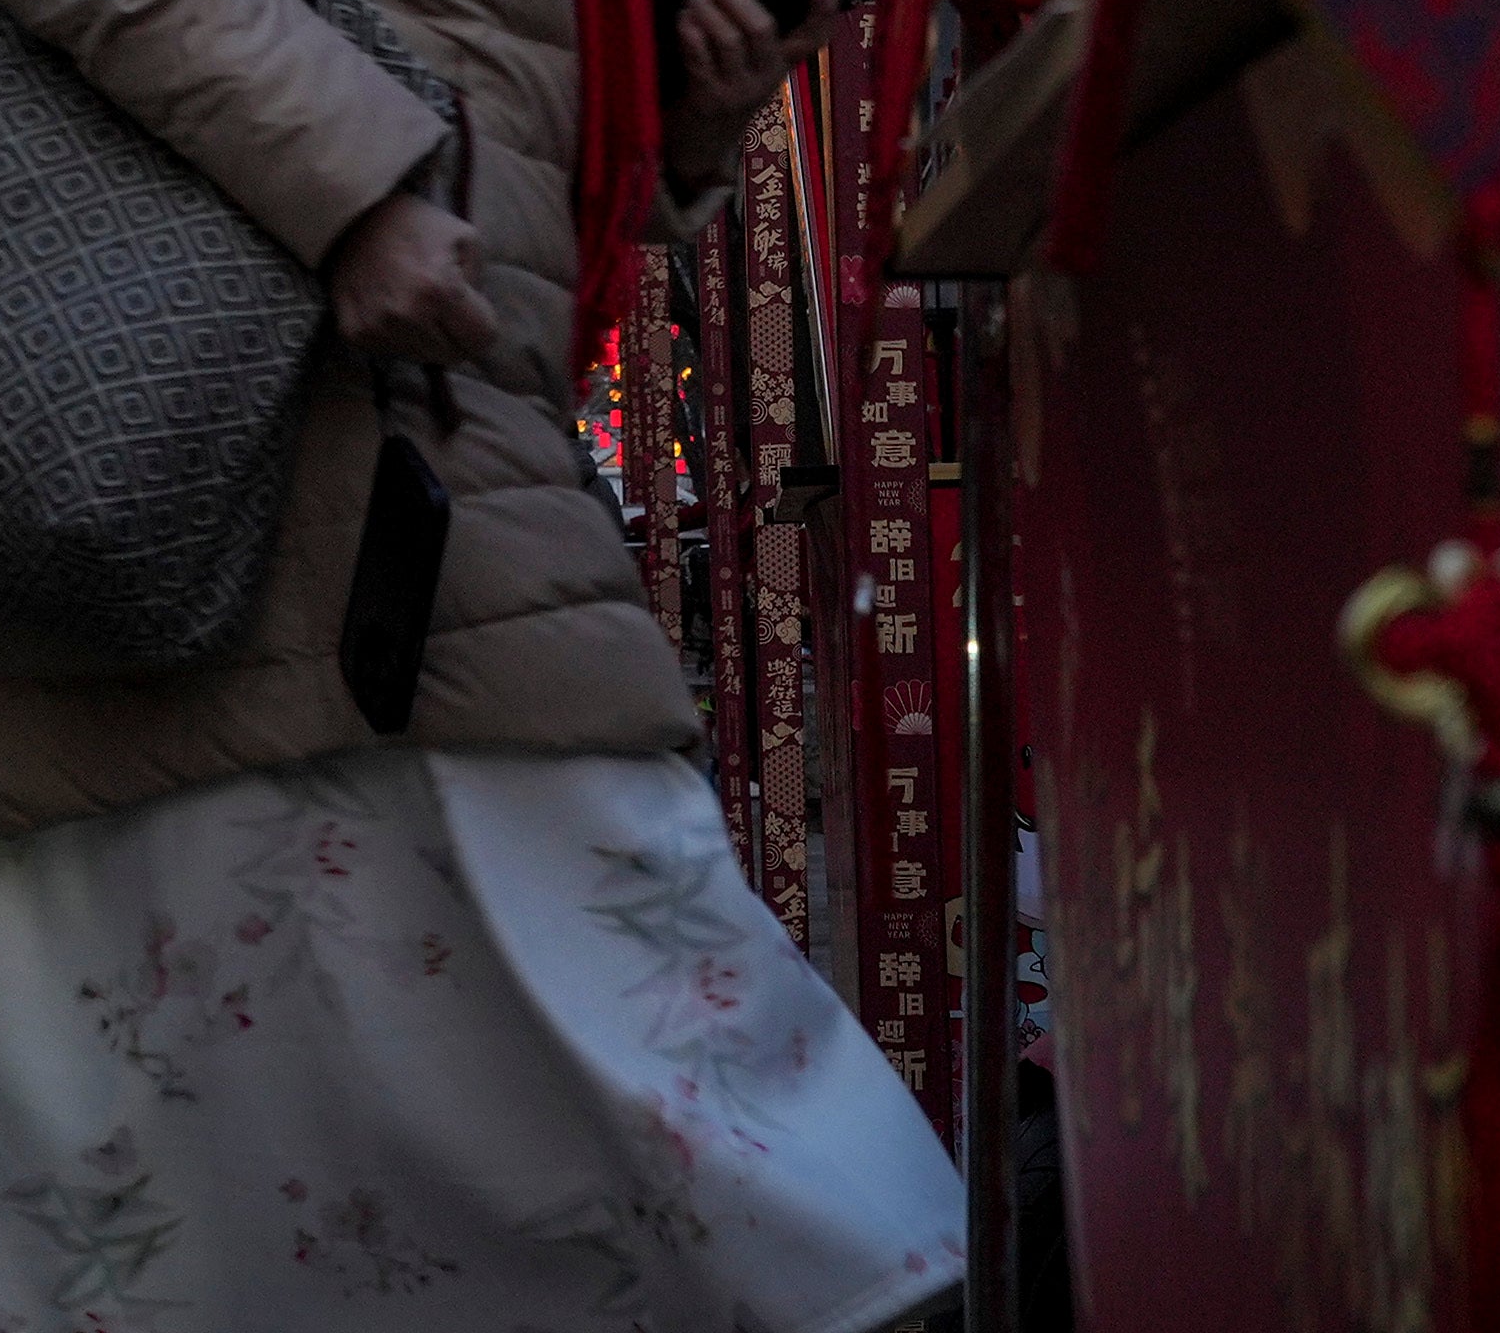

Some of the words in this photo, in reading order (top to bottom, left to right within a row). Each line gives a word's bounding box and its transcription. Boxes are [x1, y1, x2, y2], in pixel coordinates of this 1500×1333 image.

[751, 163, 789, 279] 金蛇献瑞
[861, 339, 918, 468] 万事如意
[887, 767, 929, 900] 万事意
